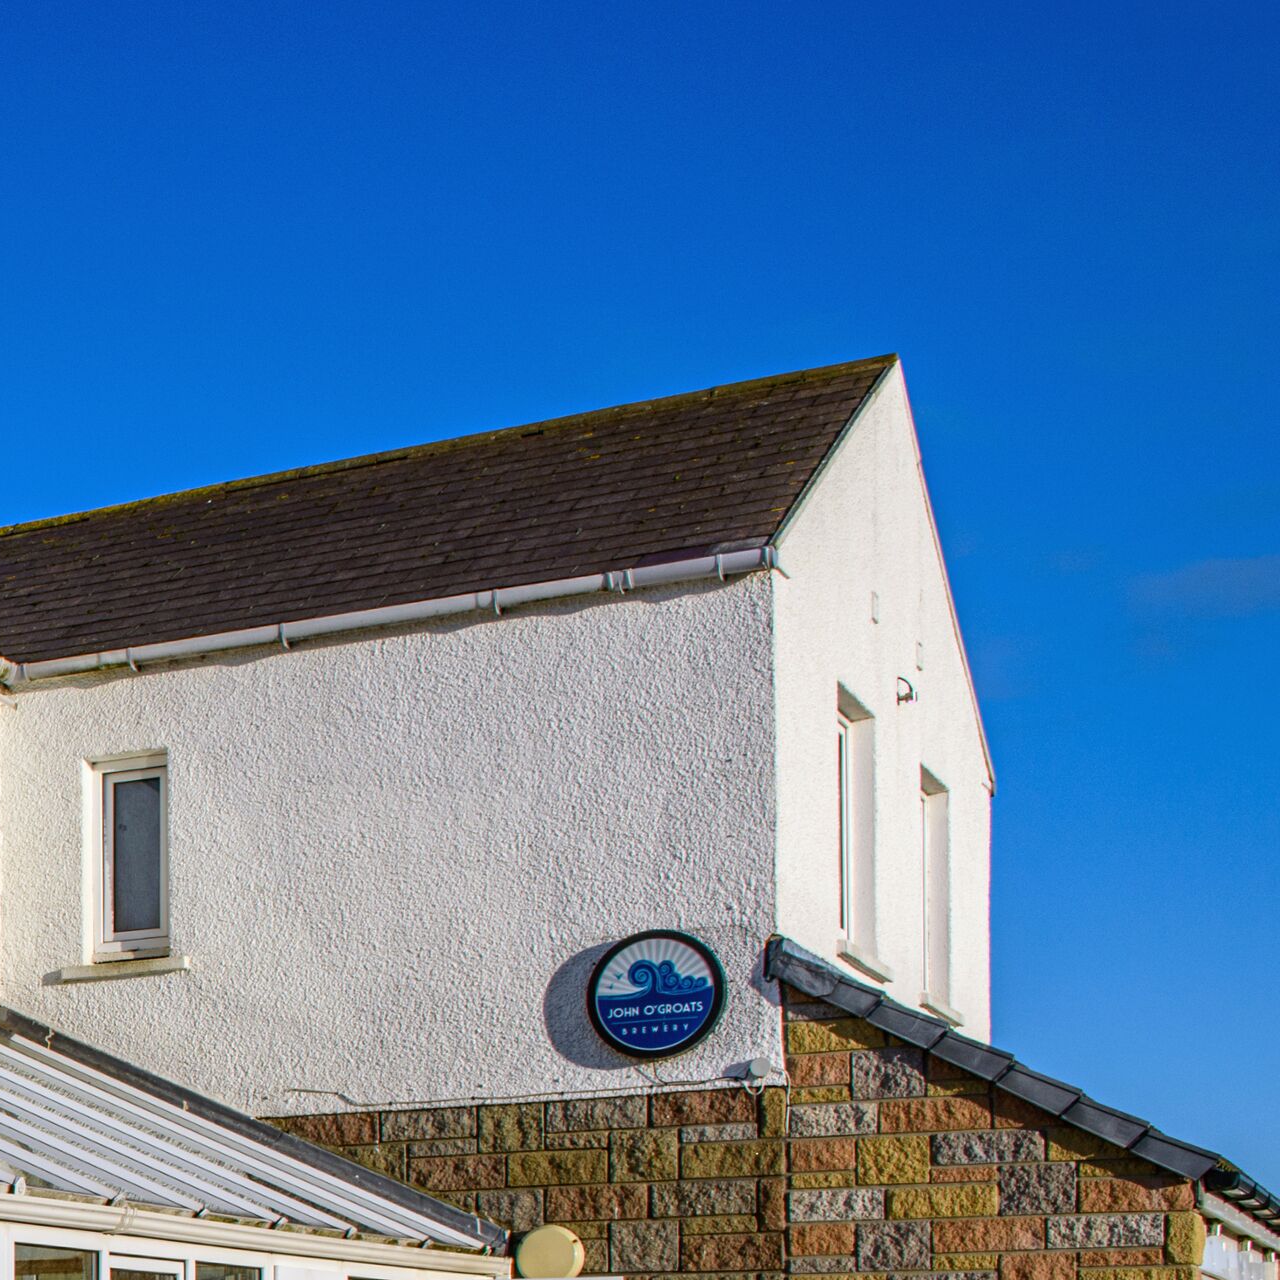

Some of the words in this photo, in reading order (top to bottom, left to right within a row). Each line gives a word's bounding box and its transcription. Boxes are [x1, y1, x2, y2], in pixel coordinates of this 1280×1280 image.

[607, 1006, 639, 1018] JOHN
[643, 1001, 703, 1015] O'GROATS
[622, 1023, 689, 1035] BREWERY
